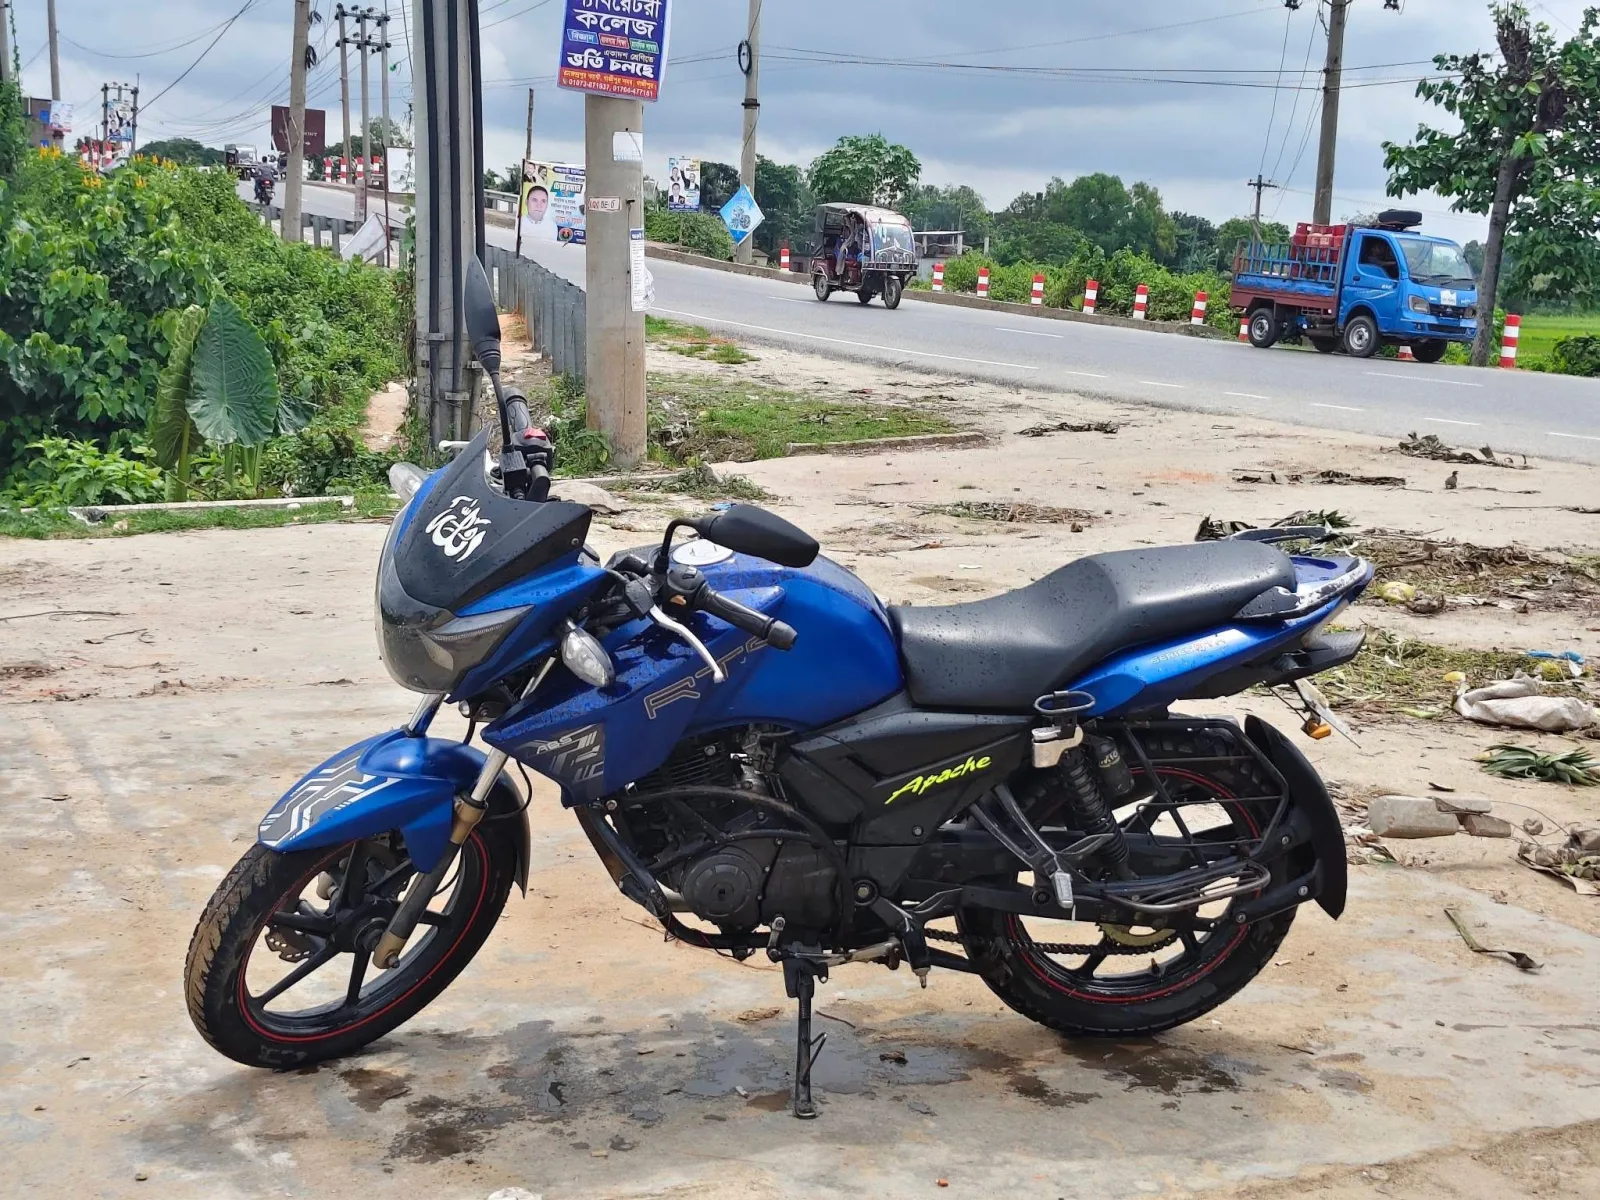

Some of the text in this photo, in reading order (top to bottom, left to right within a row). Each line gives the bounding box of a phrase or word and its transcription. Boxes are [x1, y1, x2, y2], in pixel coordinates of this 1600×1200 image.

[573, 9, 658, 38] কলেজ
[567, 48, 604, 69] ভর্তি
[609, 58, 655, 78] চলছে
[536, 736, 573, 755] ABS
[884, 755, 992, 805] Apache
